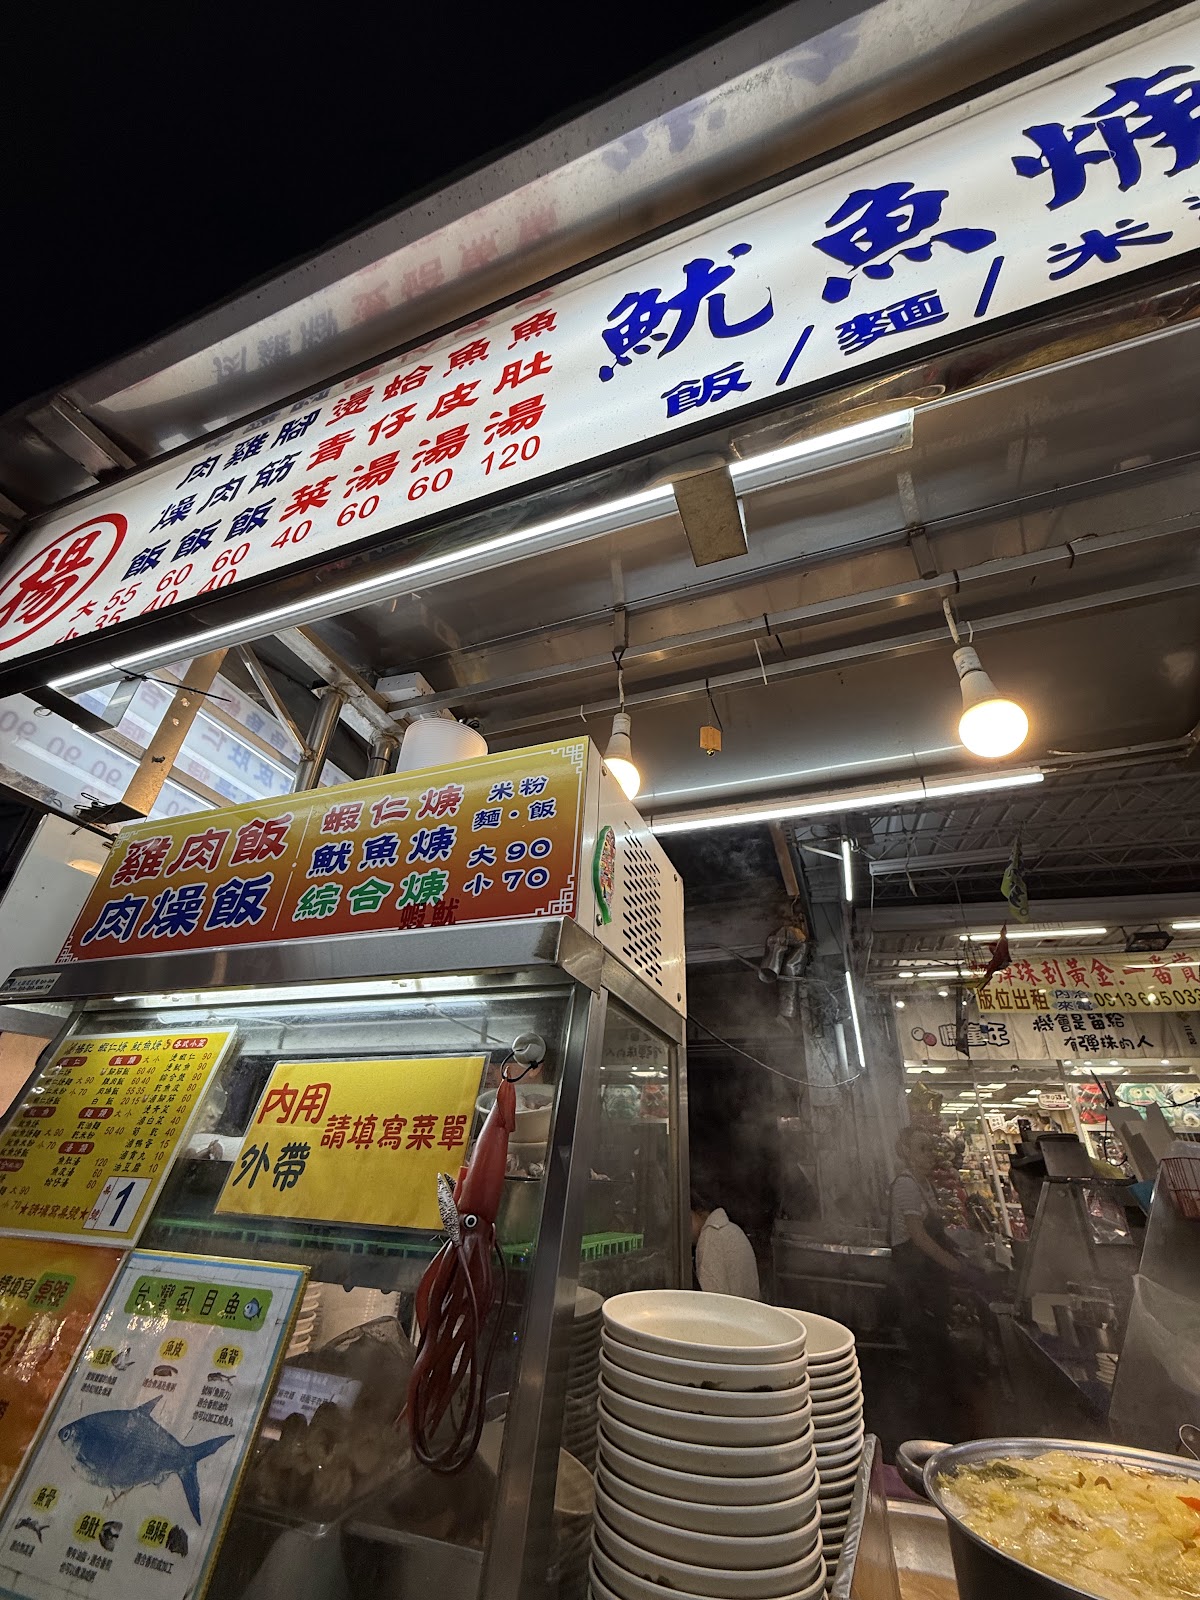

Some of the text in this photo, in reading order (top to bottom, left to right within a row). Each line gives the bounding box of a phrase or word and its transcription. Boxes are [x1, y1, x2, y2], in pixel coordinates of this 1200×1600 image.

[481, 309, 557, 475] 魚肚湯 120
[407, 337, 491, 501] 魚皮湯 60
[336, 366, 433, 526] 蛤仔湯 60
[271, 385, 374, 548] 燙青菜 40
[121, 454, 222, 581] 肉燥飯
[140, 431, 269, 615] 雞肉飯 60 40
[212, 543, 250, 572] 60
[104, 582, 142, 610] 55
[197, 569, 237, 596] 40
[69, 600, 98, 622] 大
[488, 776, 549, 802] 米粉
[321, 785, 464, 833] 蝦仁焿
[110, 814, 293, 887] 雞肉飯
[307, 826, 456, 877] 魷魚焿
[467, 838, 552, 867] 大 90
[293, 870, 448, 919] 綜合焿
[463, 867, 549, 895] 小 70
[82, 874, 273, 944] 肉燥飯
[1033, 1012, 1125, 1033] 機會是留給
[1064, 1034, 1155, 1053] 有彈珠的人
[196, 1062, 207, 1070] 90
[181, 1094, 191, 1102] 60
[159, 1140, 169, 1148] 15
[165, 1128, 175, 1136] 40
[320, 1113, 468, 1151] 請填寫菜單
[92, 1169, 102, 1177] 60
[94, 1158, 108, 1166] 120
[148, 1164, 158, 1172] 10
[232, 1141, 311, 1192] 外帶
[109, 1182, 136, 1226] 1
[164, 1340, 184, 1358] 魚皮
